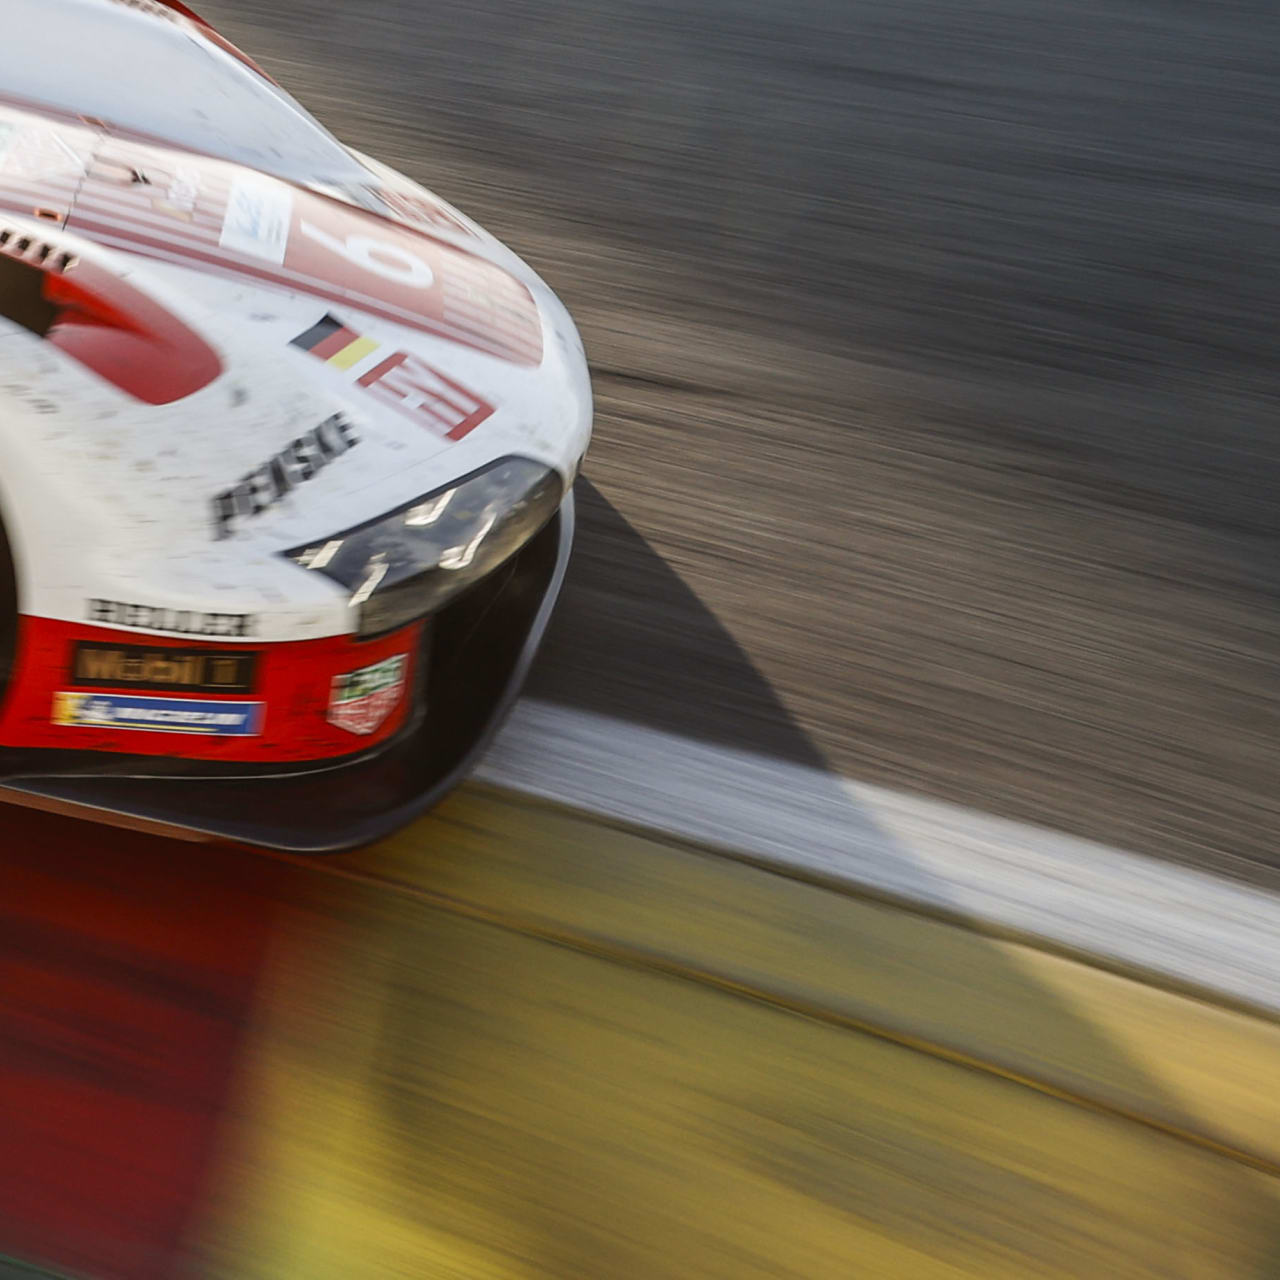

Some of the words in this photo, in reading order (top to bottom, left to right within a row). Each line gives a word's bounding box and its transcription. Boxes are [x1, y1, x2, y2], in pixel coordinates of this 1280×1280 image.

[300, 217, 434, 289] 6
[211, 411, 362, 541] PENSKE
[77, 649, 204, 685] Mobil
